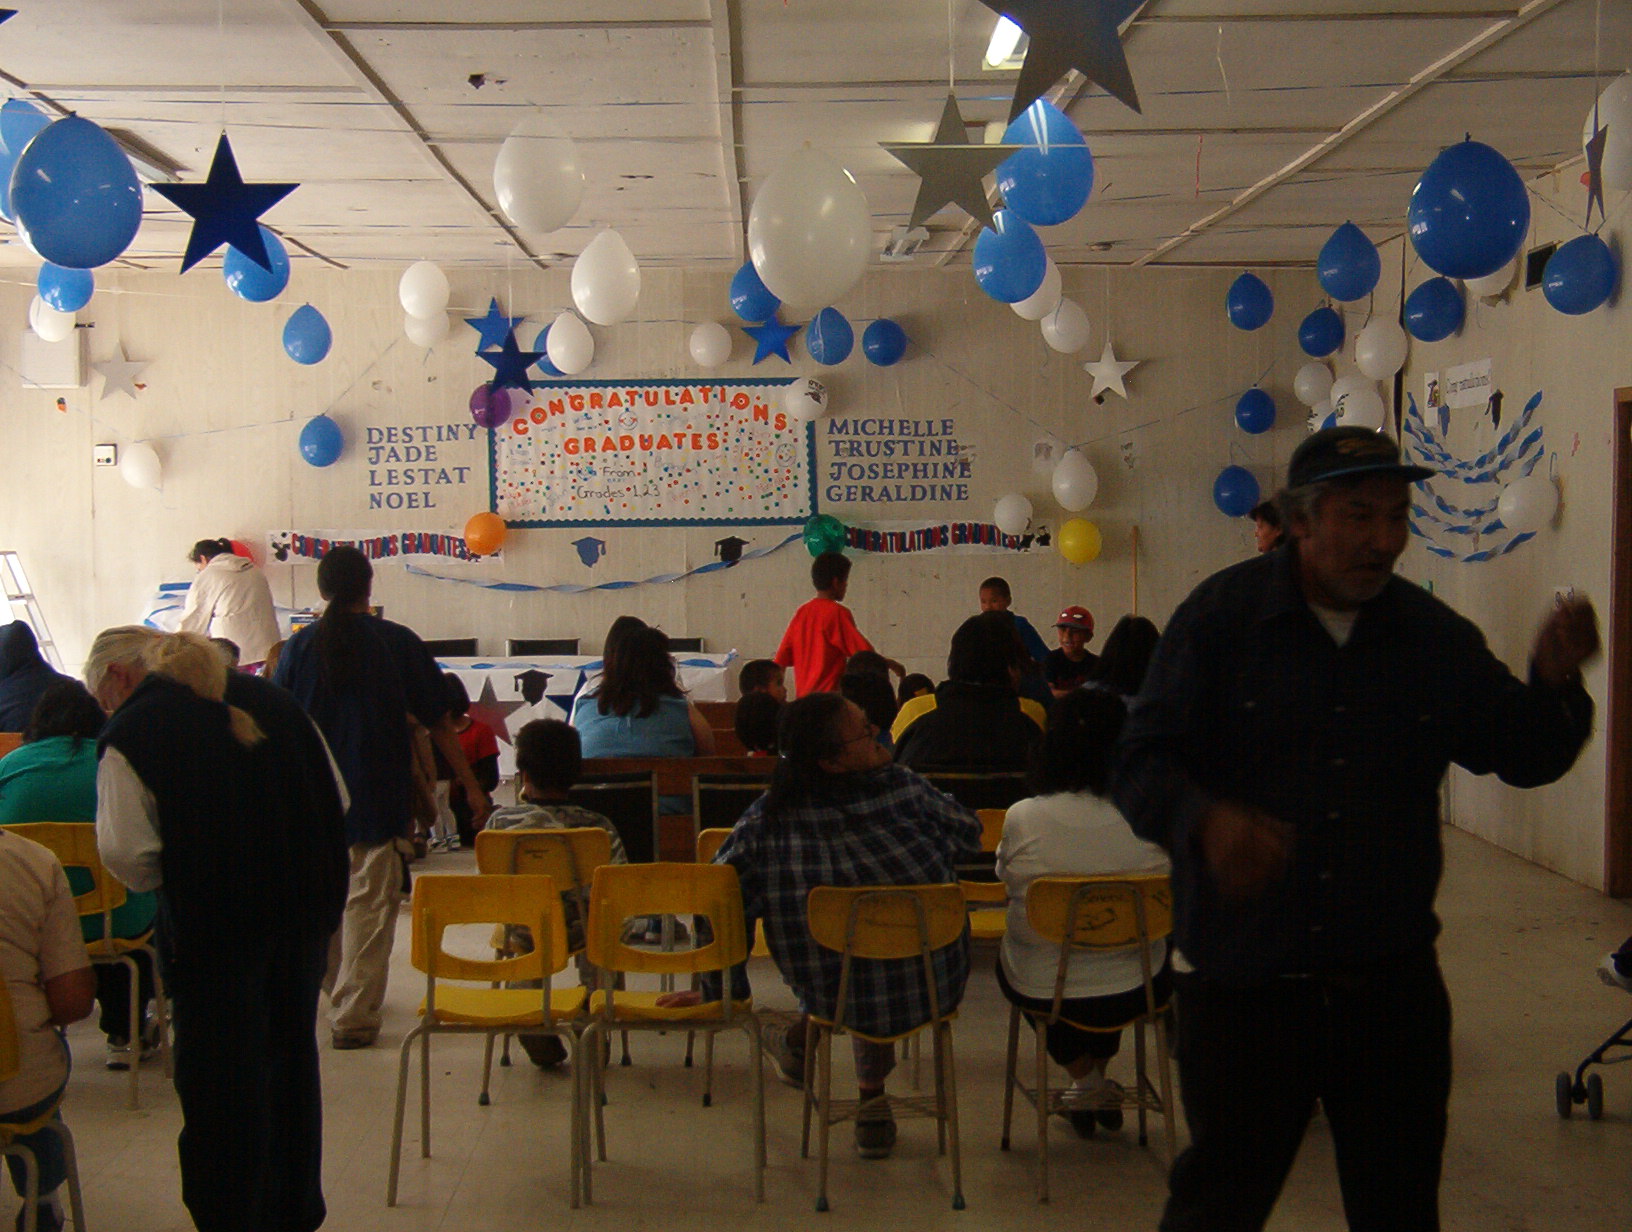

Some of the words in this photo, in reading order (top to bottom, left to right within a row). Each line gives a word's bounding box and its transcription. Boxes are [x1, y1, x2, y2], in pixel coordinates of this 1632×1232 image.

[512, 387, 788, 435] CONGRATULATIONS
[366, 424, 478, 444] DESTINY
[827, 418, 954, 437] MICHELLE
[564, 432, 719, 455] GRADUATES
[828, 439, 960, 458] TRUSTINE
[368, 445, 437, 465] JADE
[368, 467, 471, 486] LESTAT
[603, 466, 636, 477] From
[829, 461, 972, 481] JOSEPHINE
[369, 491, 436, 509] NOEL
[577, 485, 626, 499] Grades
[825, 484, 969, 503] GERALDINE
